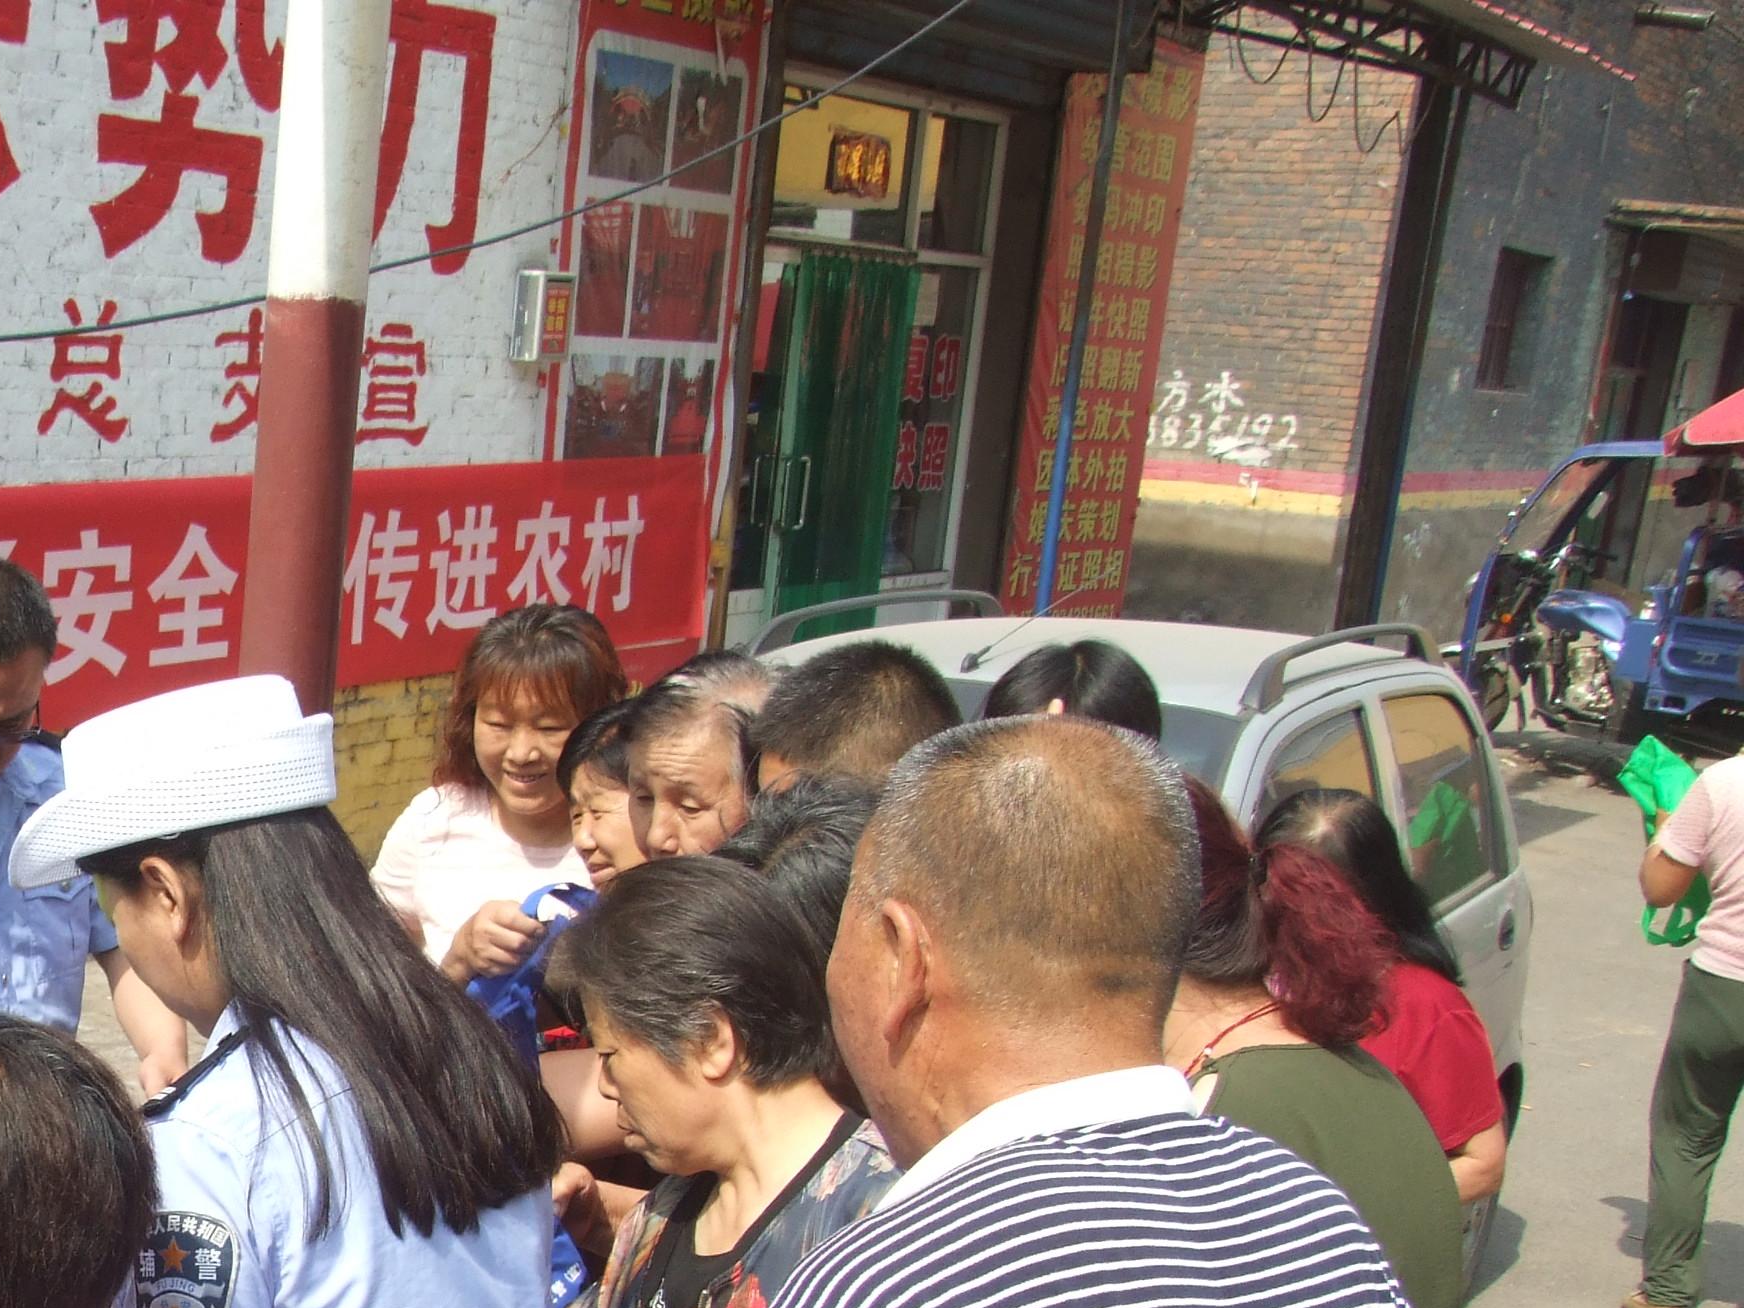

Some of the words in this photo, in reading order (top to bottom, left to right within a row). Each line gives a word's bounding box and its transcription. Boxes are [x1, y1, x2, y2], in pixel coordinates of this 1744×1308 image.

[1008, 548, 1124, 598] 行证照相
[145, 1215, 230, 1248] 人民共和国
